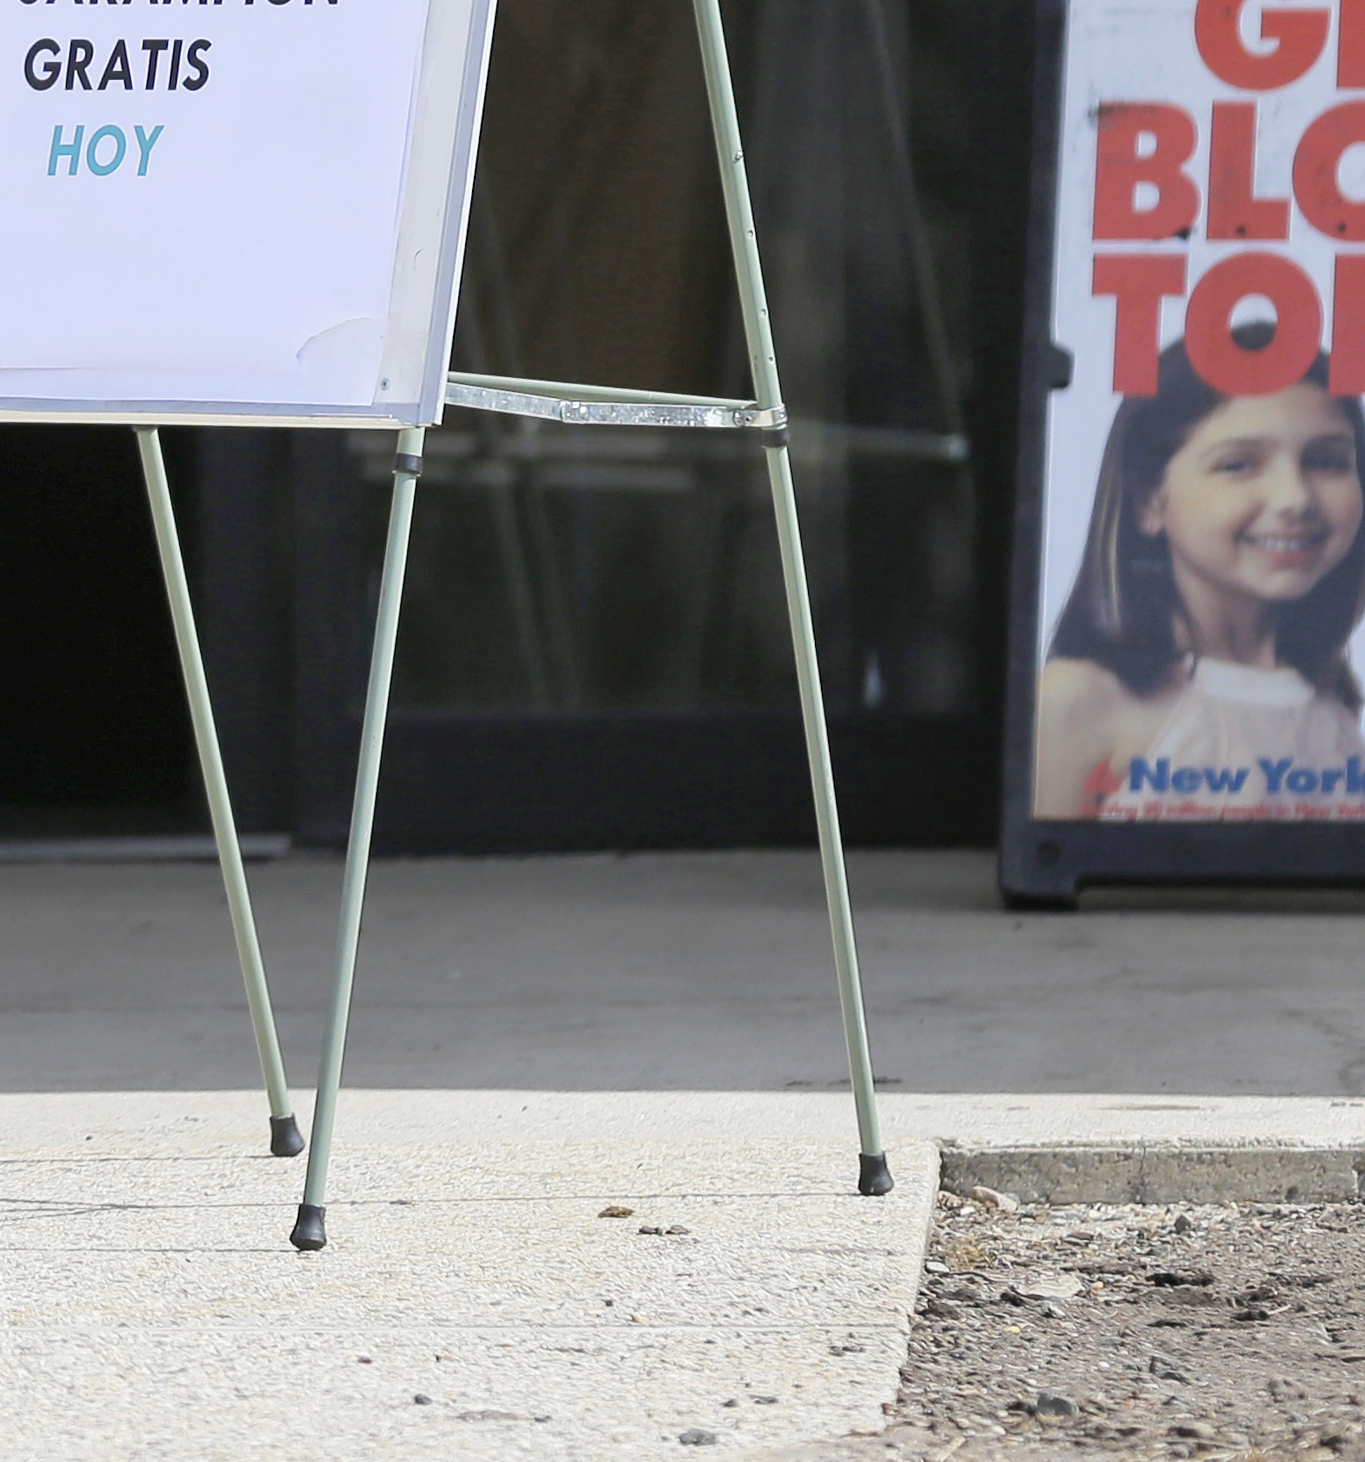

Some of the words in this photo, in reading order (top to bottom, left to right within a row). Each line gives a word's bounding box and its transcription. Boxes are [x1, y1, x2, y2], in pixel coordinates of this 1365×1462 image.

[23, 38, 212, 92] GRATIS
[47, 124, 164, 178] HOY
[1129, 756, 1250, 794] New
